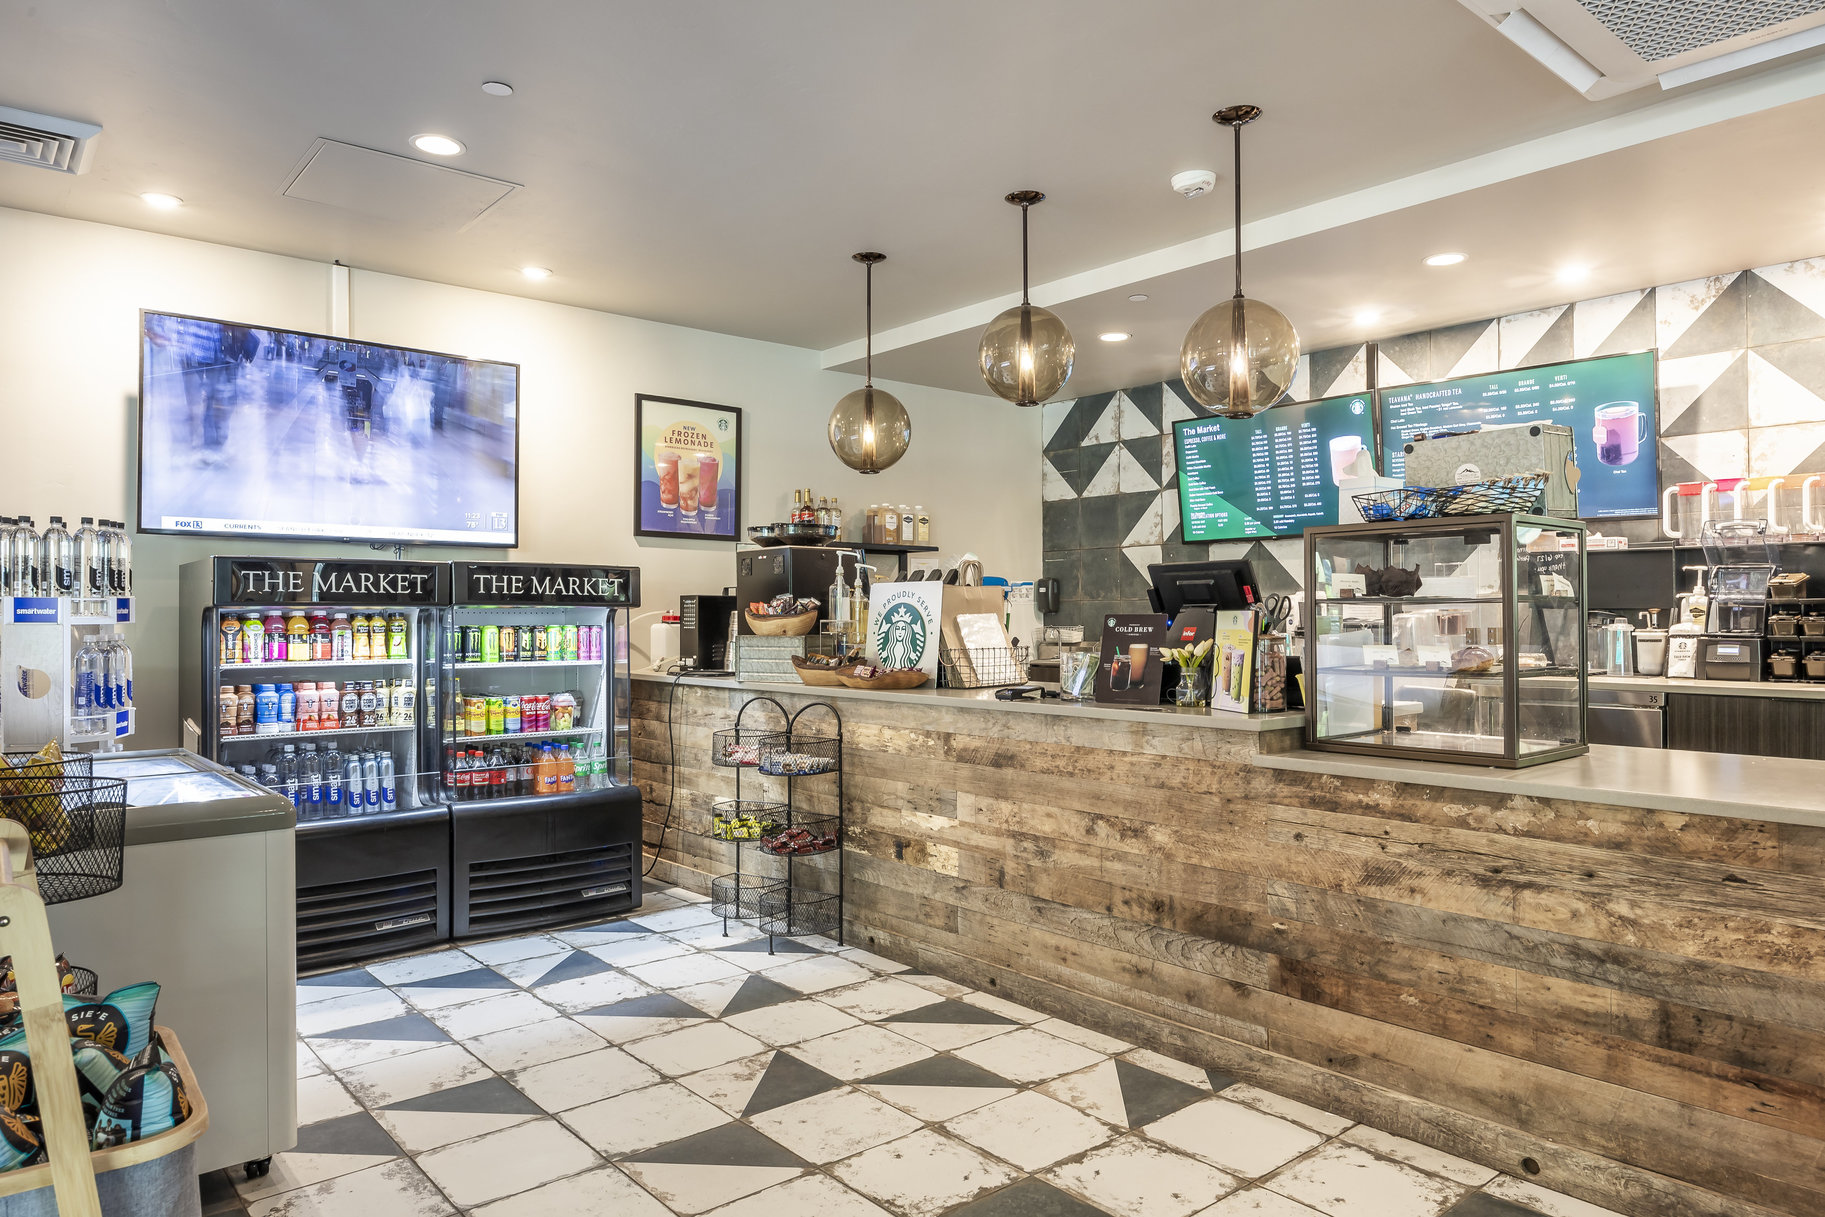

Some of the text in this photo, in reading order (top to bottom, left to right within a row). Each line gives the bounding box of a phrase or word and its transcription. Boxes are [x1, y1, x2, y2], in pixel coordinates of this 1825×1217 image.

[1415, 390, 1452, 400] HANDCRAFTED
[672, 430, 707, 440] FROZEN
[1183, 424, 1220, 436] The Market
[664, 436, 714, 448] LEMONADE
[241, 571, 428, 594] THE MARKET
[473, 574, 624, 596] THE MARKET
[874, 590, 933, 626] WE PROUDLY SERVE
[593, 762, 606, 772] Spri
